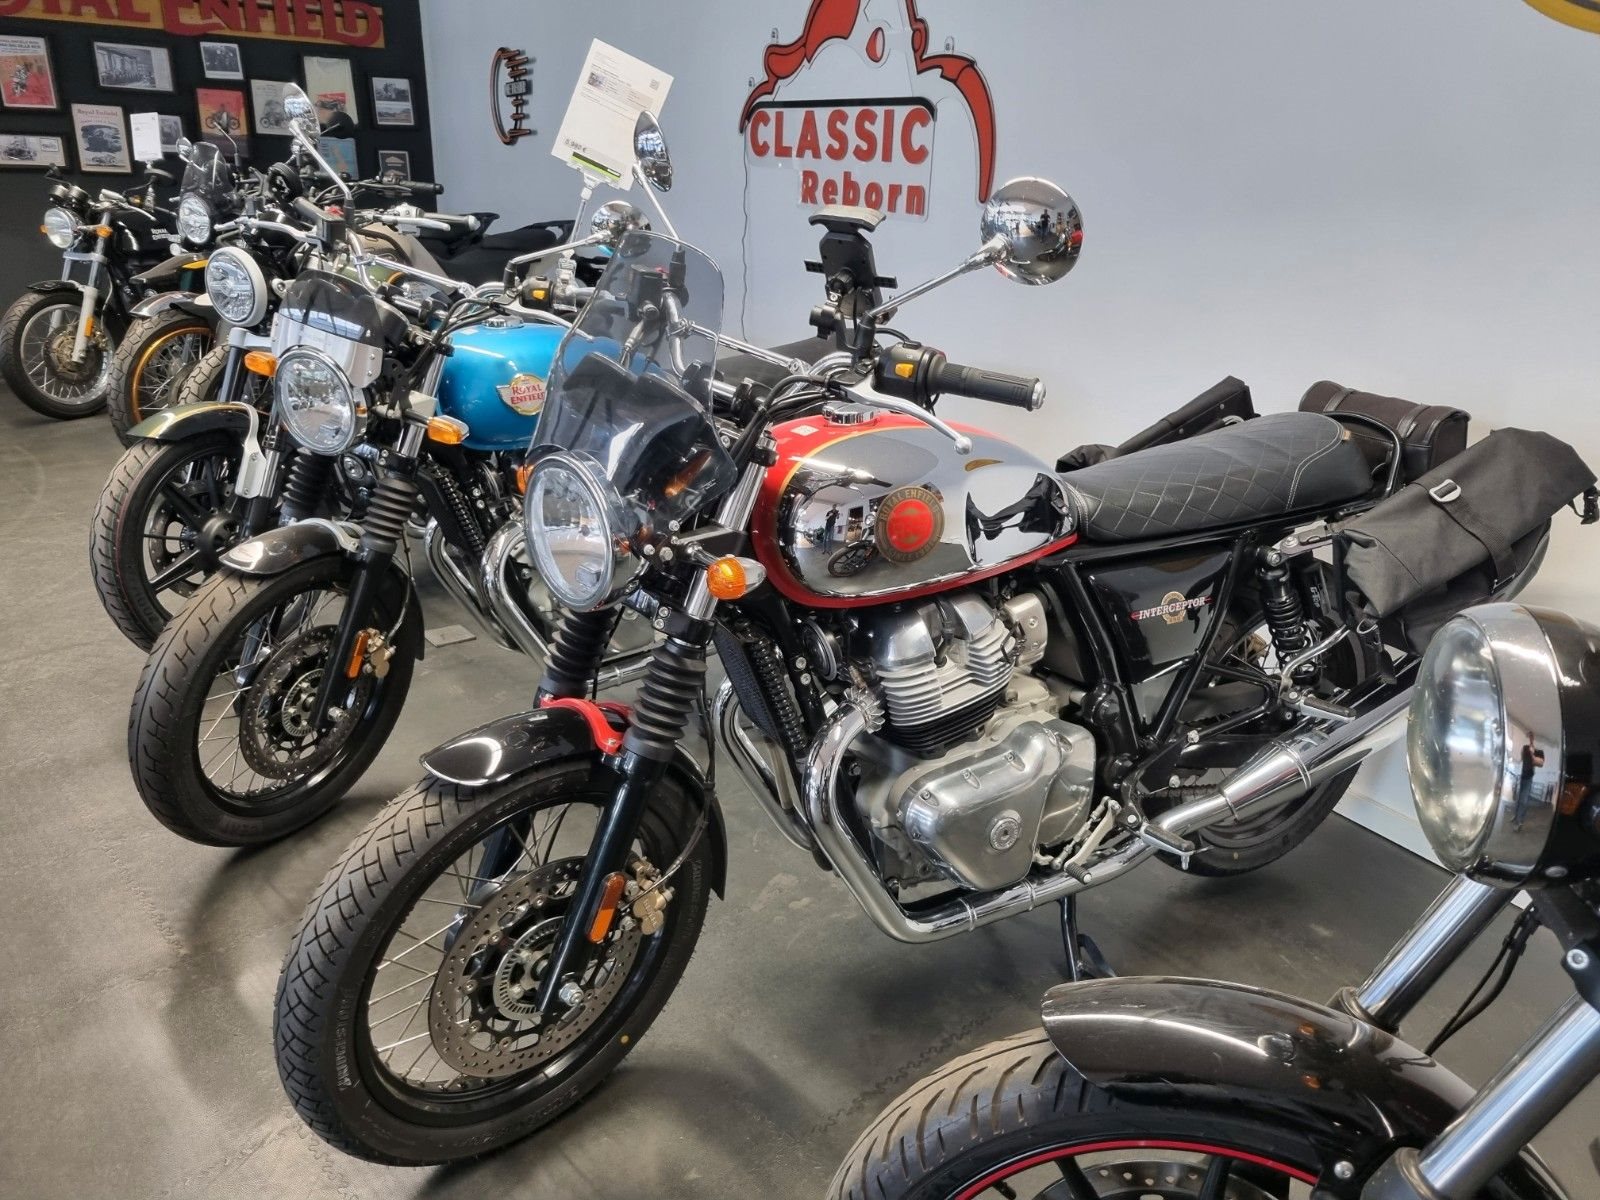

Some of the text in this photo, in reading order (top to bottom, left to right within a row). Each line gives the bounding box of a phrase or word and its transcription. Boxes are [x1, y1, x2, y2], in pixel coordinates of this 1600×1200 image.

[162, 0, 381, 47] ENFIELD
[750, 107, 931, 164] CLASSIC
[801, 170, 925, 215] Reborn
[512, 384, 542, 395] ROYAL
[880, 493, 904, 521] ROYAL
[1139, 597, 1206, 620] INTERCEPTOR
